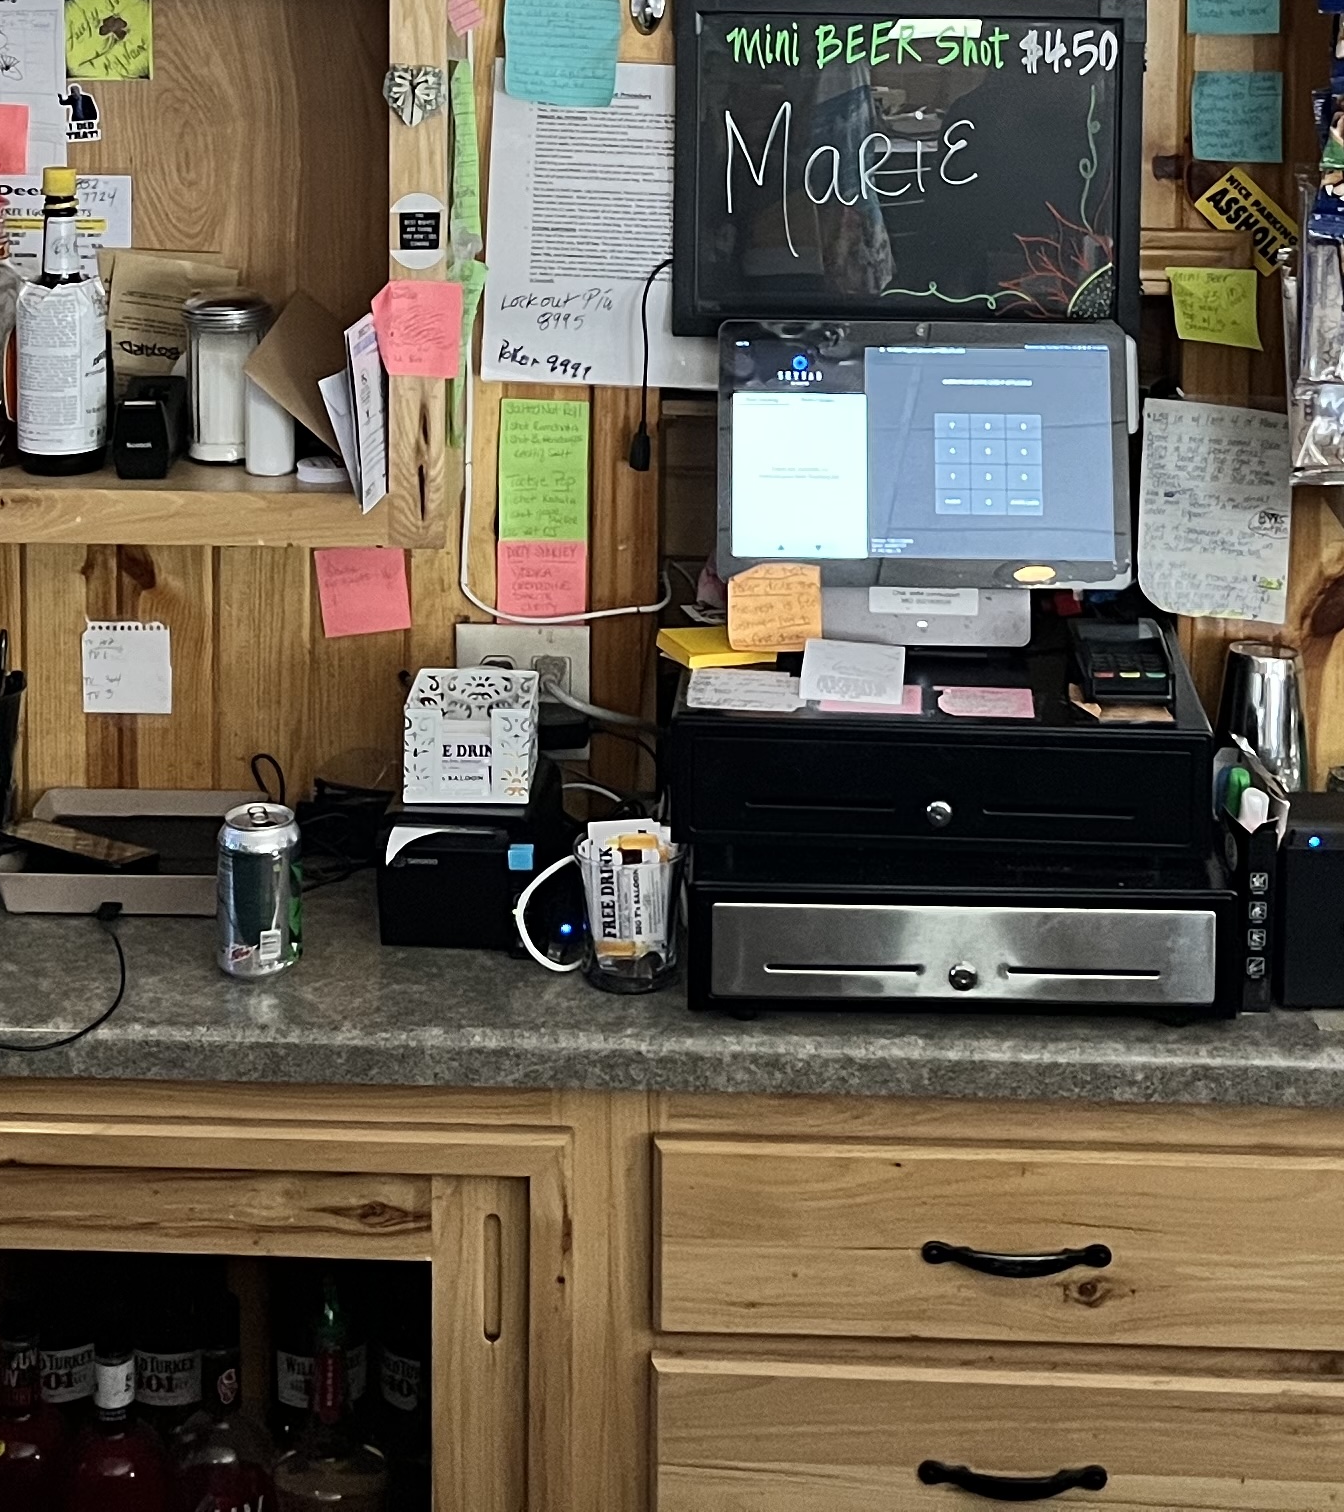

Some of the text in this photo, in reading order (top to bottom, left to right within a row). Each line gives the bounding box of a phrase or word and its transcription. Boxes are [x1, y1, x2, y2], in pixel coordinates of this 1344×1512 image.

[815, 20, 1118, 76] BEER Shot $4.50
[1225, 171, 1253, 201] NICE
[1249, 195, 1299, 250] PARKING
[537, 312, 585, 330] 8995
[599, 845, 617, 939] FREE DRINK
[633, 869, 642, 905] SALOON
